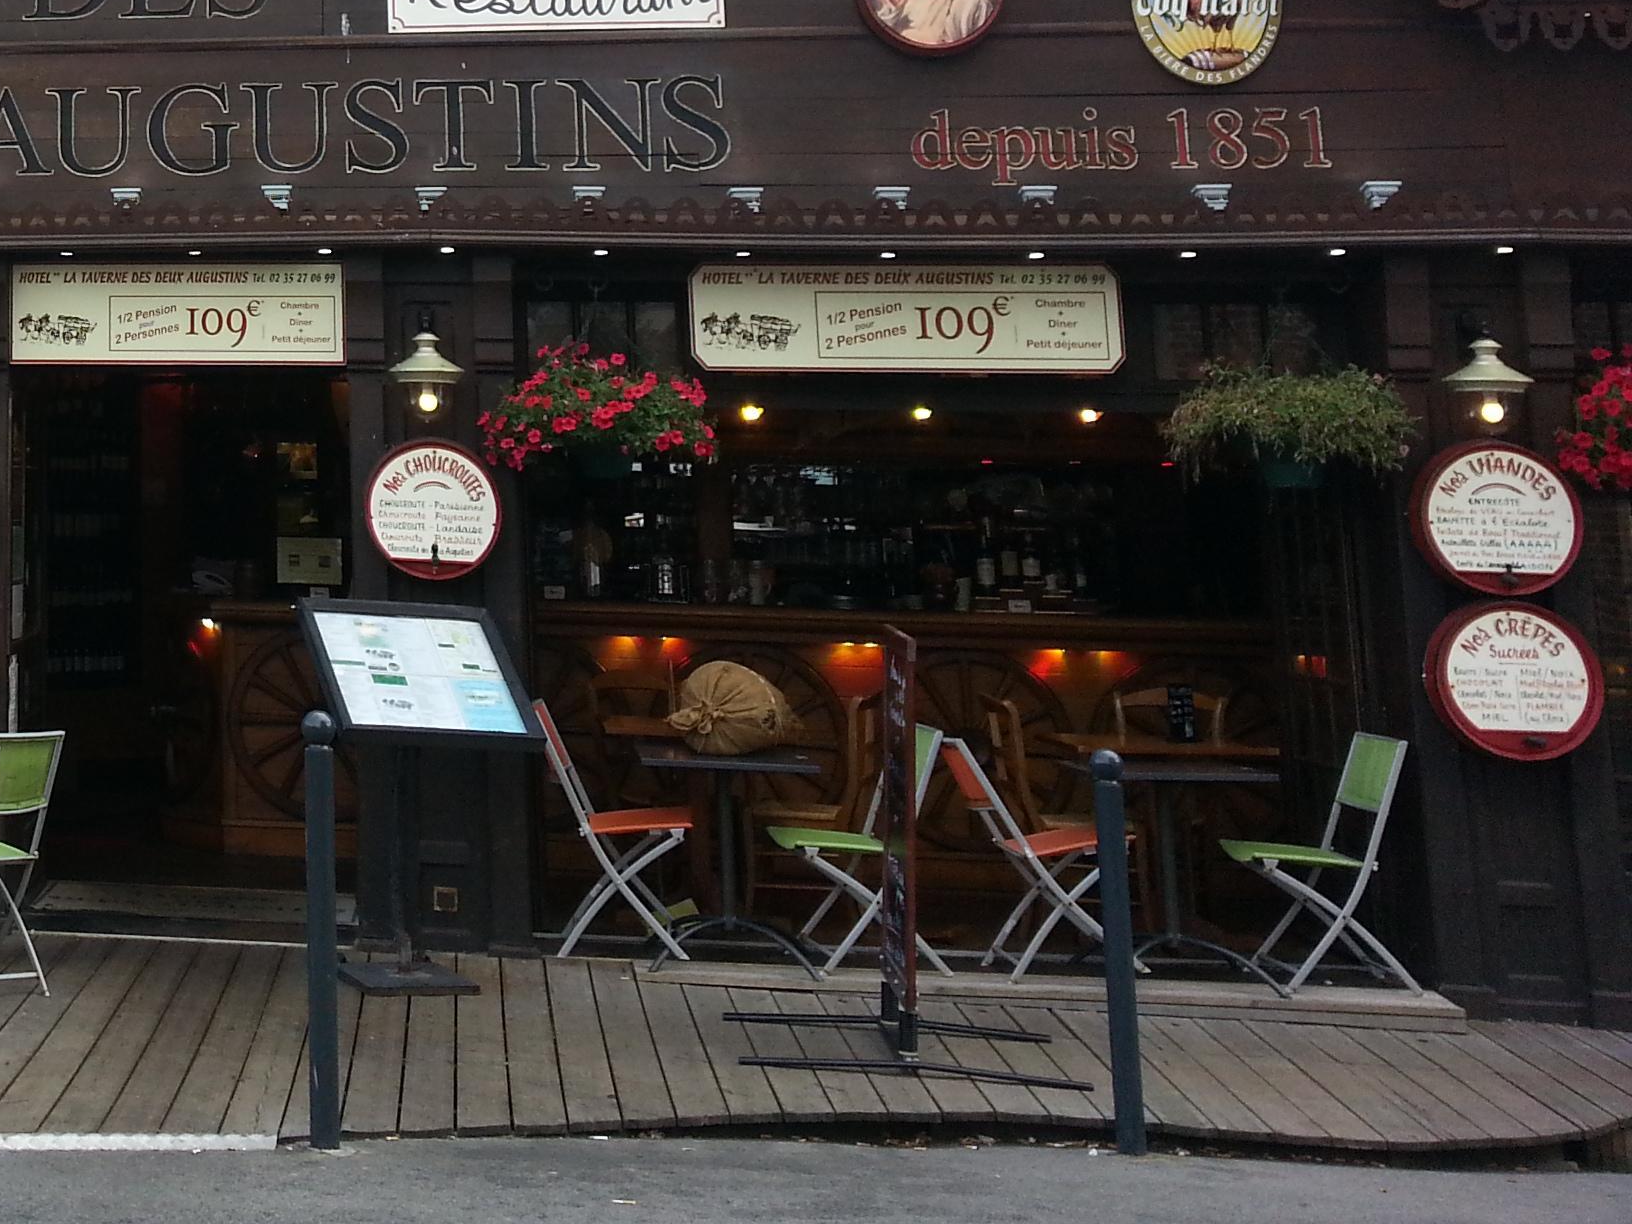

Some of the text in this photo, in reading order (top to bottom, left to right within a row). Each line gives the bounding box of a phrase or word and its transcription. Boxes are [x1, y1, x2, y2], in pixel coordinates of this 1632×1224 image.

[1140, 25, 1154, 41] LA
[1196, 71, 1222, 83] DES
[1230, 25, 1278, 79] FLANDRES
[910, 106, 1333, 186] depuis 1851
[18, 271, 52, 284] HOTEL
[63, 271, 77, 284] LA
[81, 271, 129, 284] TAVERNE
[131, 271, 152, 284] DES
[155, 271, 183, 284] DEUX
[186, 271, 249, 284] AUGUSTINS
[269, 273, 280, 283] 02
[283, 273, 294, 283] 35
[297, 273, 308, 283] 27
[324, 273, 336, 283] 99
[701, 271, 1107, 285] HOTEL LA TAVERNE DES DEUX AUGUSTINS 02 35 27 06 99
[116, 304, 177, 325] 1/2 Pension
[280, 301, 320, 310] Chambre
[826, 302, 902, 326] 1/2 Pension
[1035, 299, 1086, 309] Chambre
[115, 323, 180, 345] 2 Personnes
[854, 321, 875, 332] pour
[271, 335, 291, 343] Petit
[825, 325, 908, 350] 2 Personnes
[1026, 339, 1052, 349] Petit
[382, 471, 408, 496] Nos
[1439, 456, 1557, 502] Nos VIANDES
[1460, 616, 1566, 659] Nos CRÊPES
